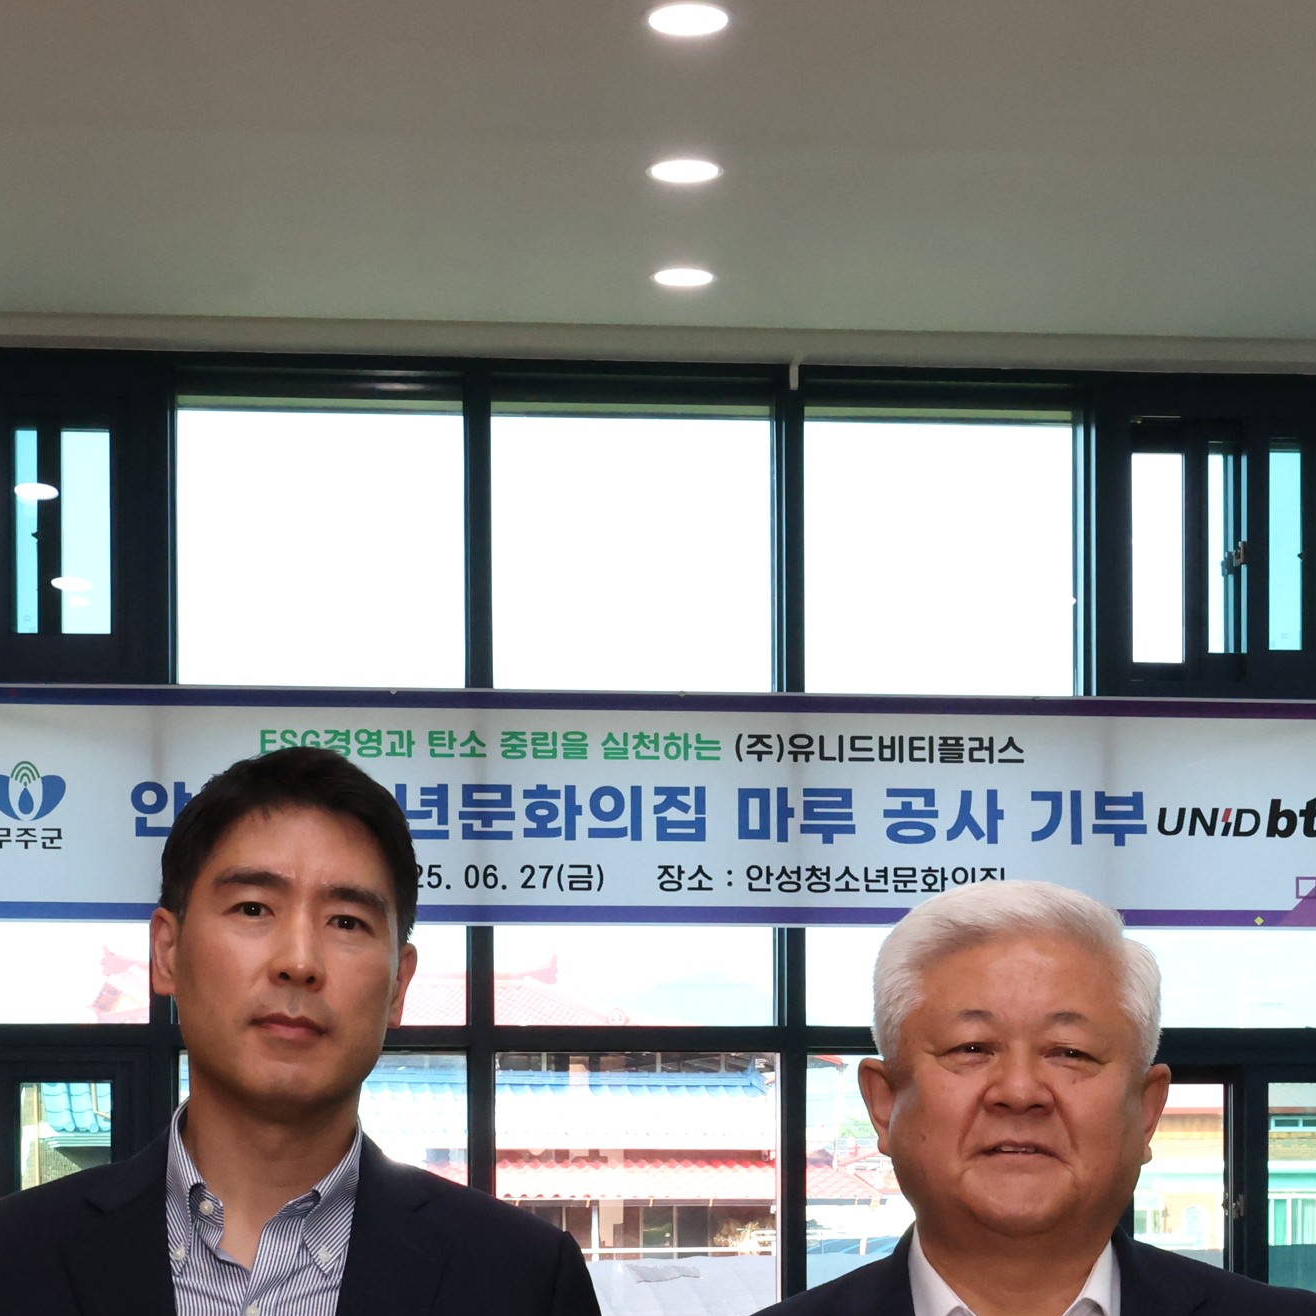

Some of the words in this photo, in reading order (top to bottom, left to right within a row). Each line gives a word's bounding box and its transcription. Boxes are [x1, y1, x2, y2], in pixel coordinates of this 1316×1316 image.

[259, 728, 416, 758] ESG경영과
[428, 729, 487, 758] 탄소
[500, 730, 589, 760] 중립을
[601, 731, 722, 761] 실천하는
[734, 733, 1025, 765] (주)유니드비티플러스
[130, 780, 707, 843] 안년문화의집
[737, 786, 856, 845] 마루
[882, 787, 1005, 845] 공사
[1030, 789, 1148, 847] 기부
[464, 863, 508, 891] 06.
[519, 863, 604, 893] 27(금)
[657, 864, 714, 893] 장소
